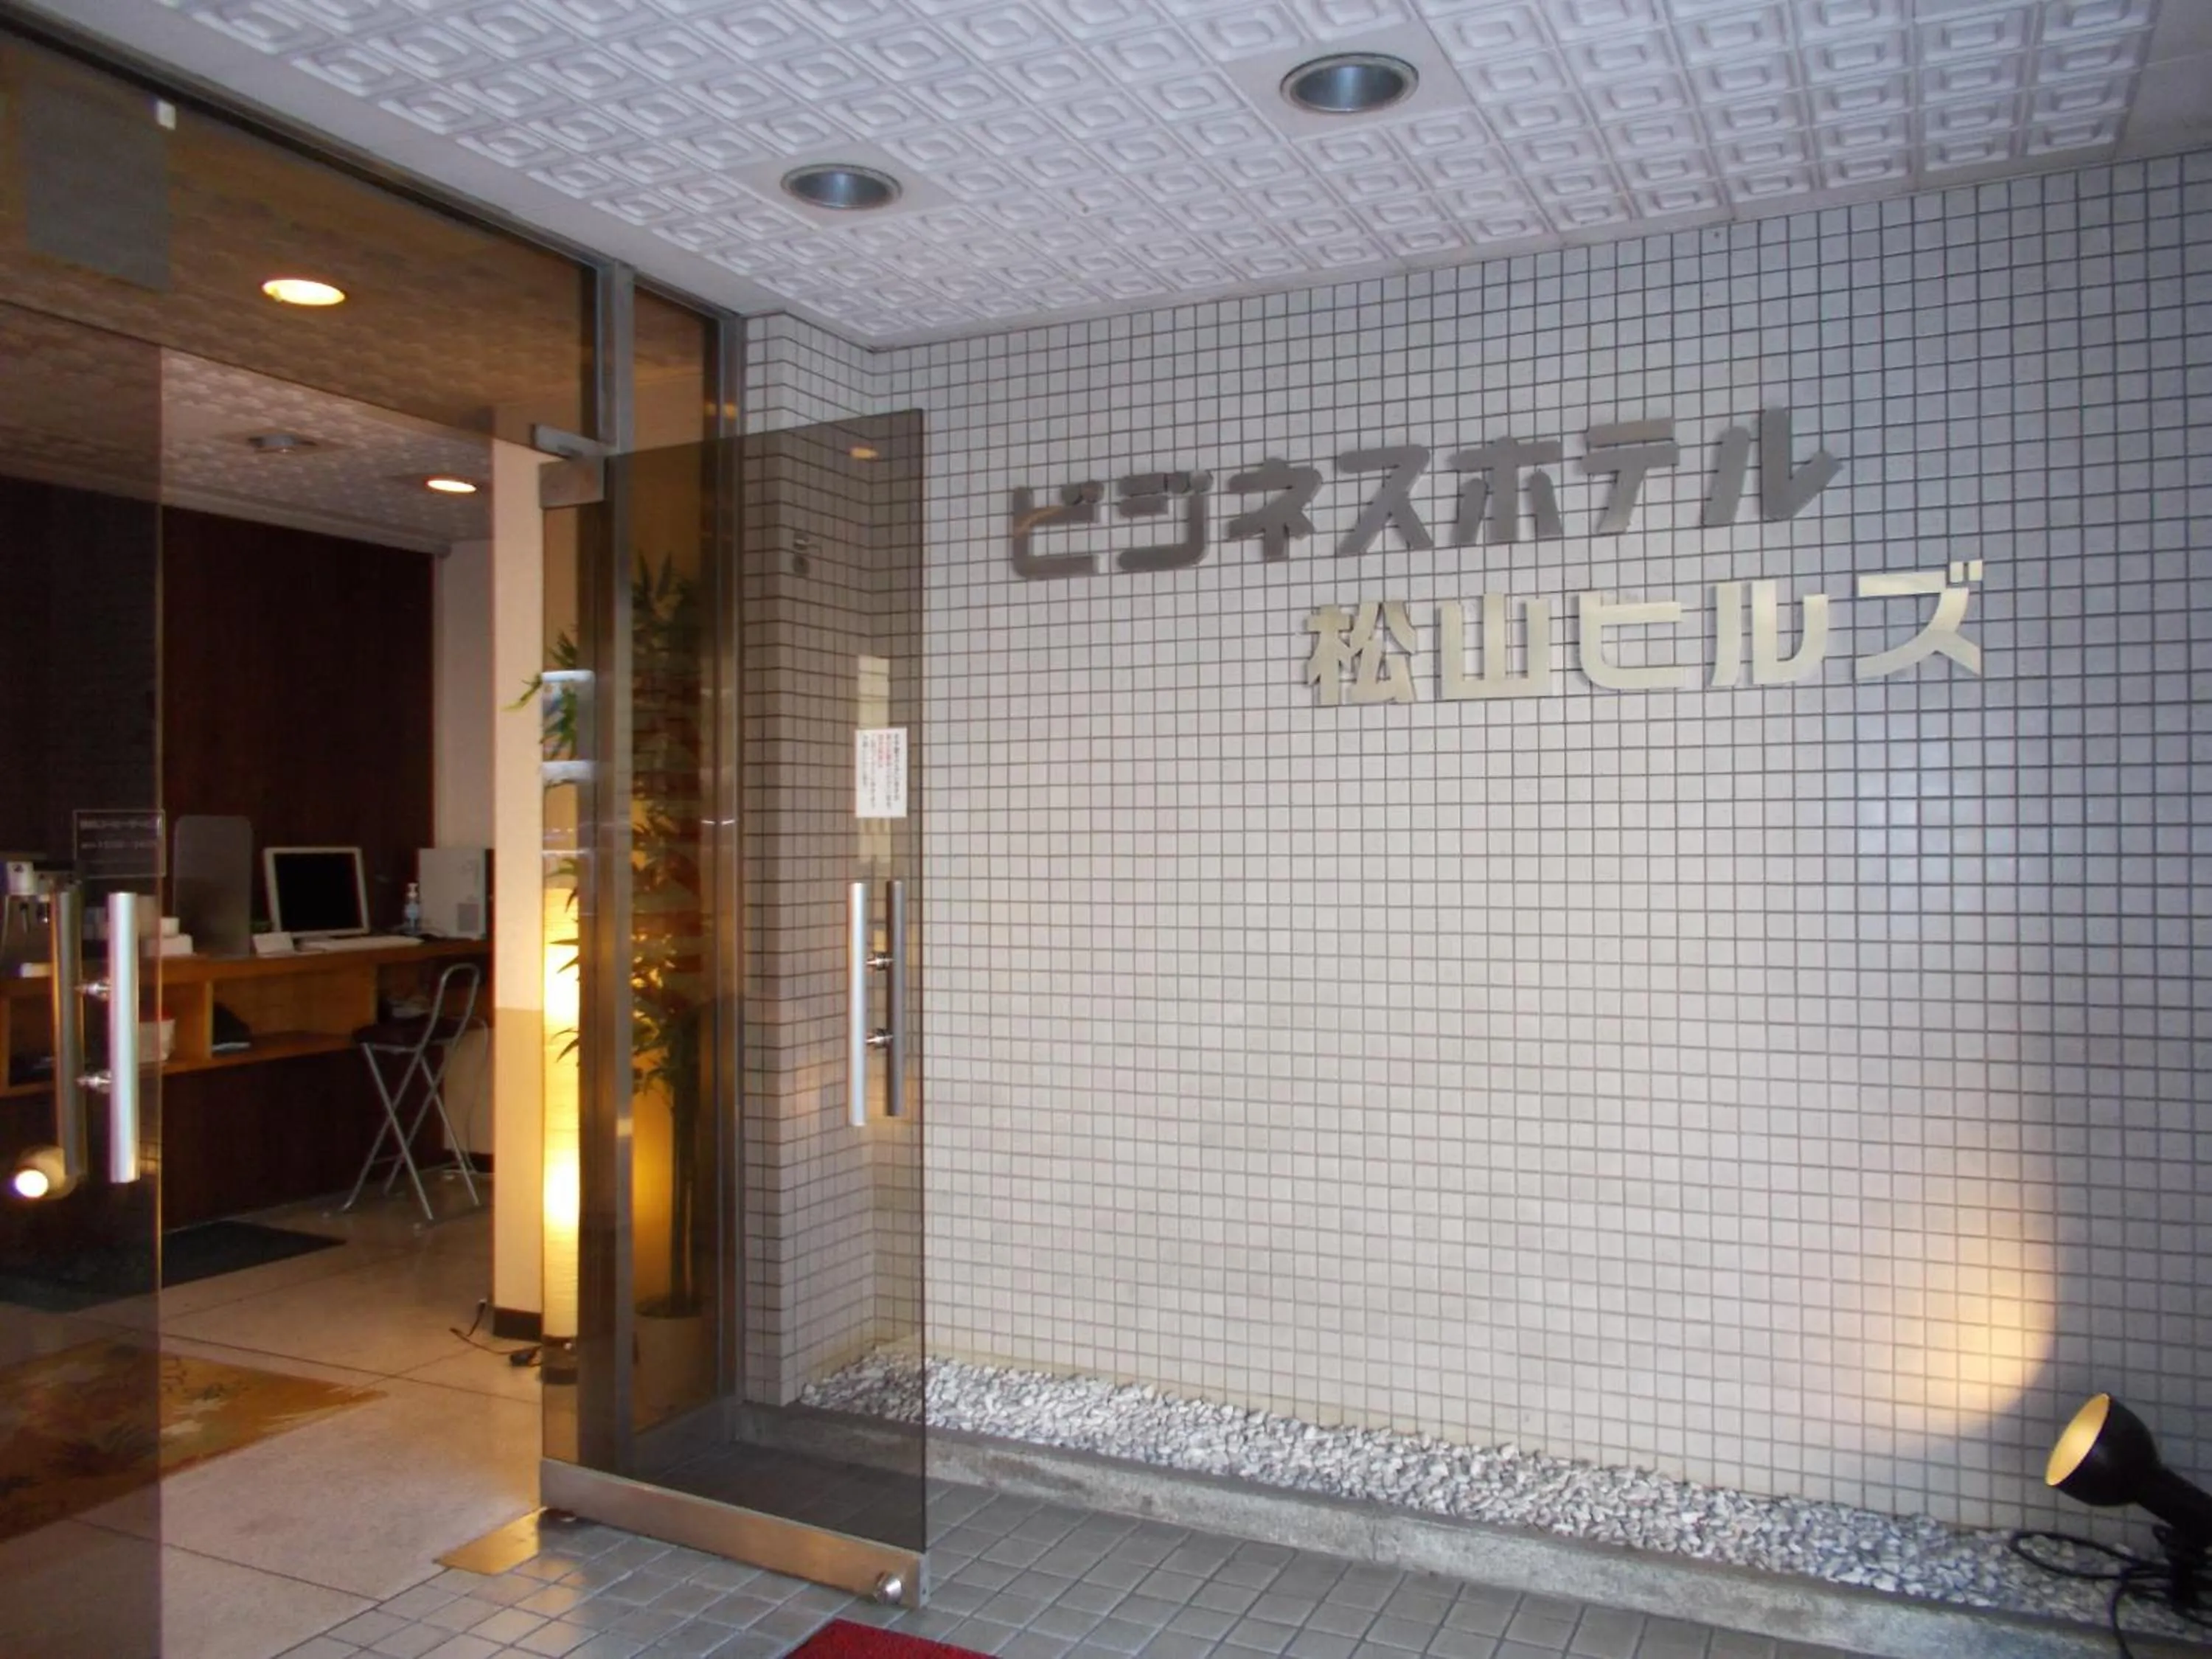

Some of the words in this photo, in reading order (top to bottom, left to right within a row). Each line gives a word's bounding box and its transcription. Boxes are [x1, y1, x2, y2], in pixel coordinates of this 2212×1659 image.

[1012, 407, 1843, 580] ビジネスホテル
[1307, 559, 1983, 706] 松山ヒルズ
